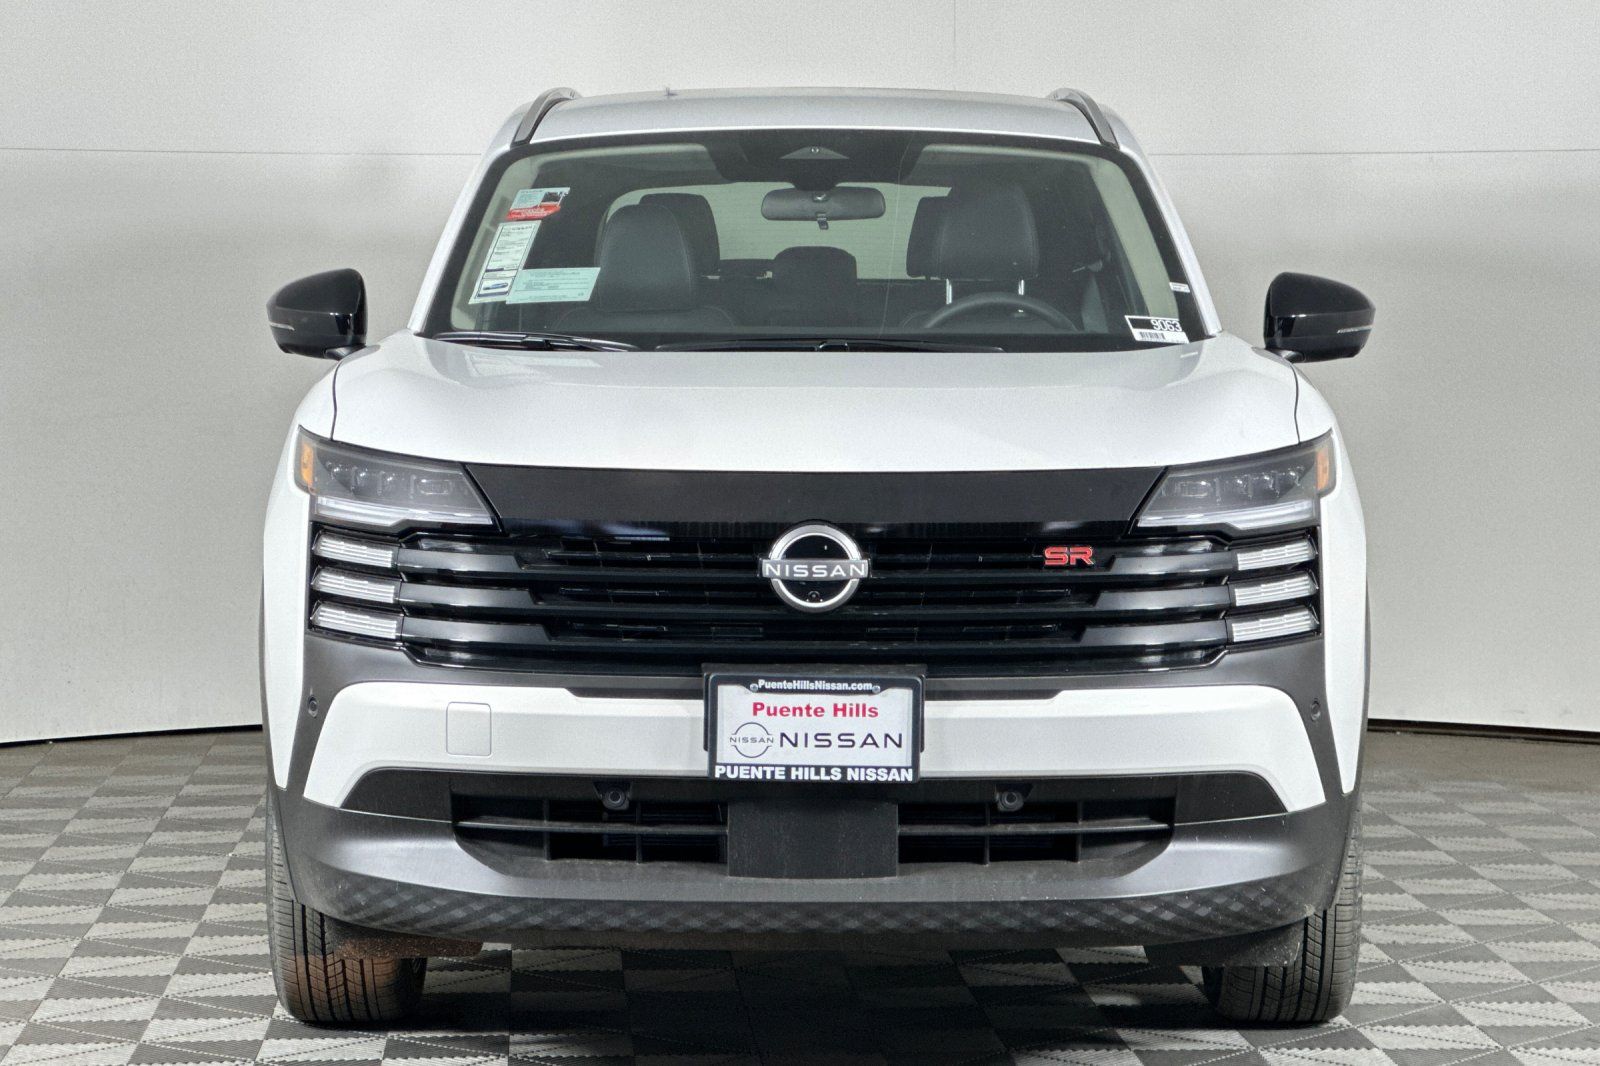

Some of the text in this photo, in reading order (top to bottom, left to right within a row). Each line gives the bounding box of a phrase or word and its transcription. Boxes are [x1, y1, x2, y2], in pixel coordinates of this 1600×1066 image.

[1150, 319, 1182, 332] 9063
[1044, 546, 1094, 565] SR
[765, 563, 865, 577] NISSAN
[758, 679, 873, 691] PuenteHillsNissan.com
[752, 702, 879, 718] Puente Hills
[729, 736, 774, 744] NISSAN
[780, 732, 903, 748] NISSAN
[714, 766, 913, 782] PUENTE HILLS NISSAN
